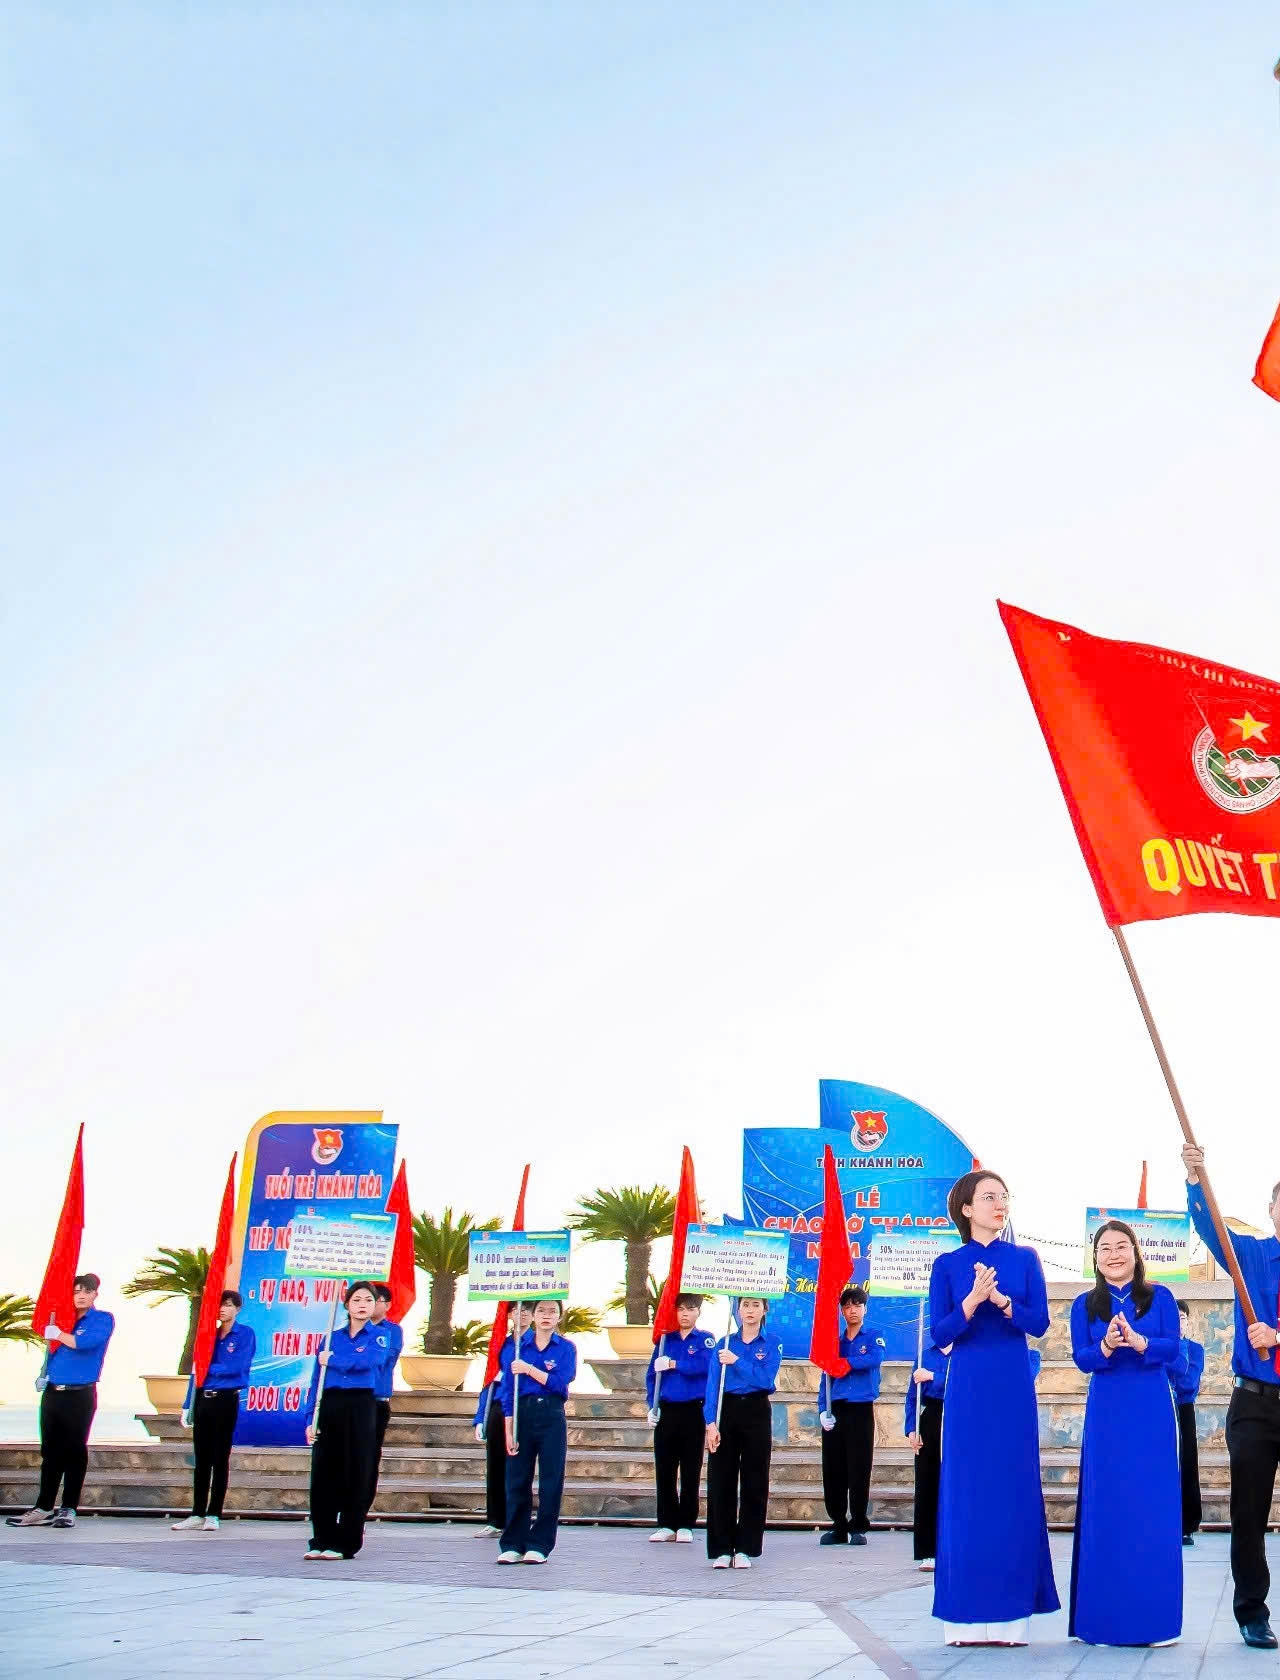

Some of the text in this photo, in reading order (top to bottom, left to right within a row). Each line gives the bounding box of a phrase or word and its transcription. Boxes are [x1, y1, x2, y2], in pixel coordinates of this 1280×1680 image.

[1141, 833, 1251, 896] QUYẾT
[816, 1154, 924, 1168] TH KHÁNH HÒA
[315, 1169, 357, 1199] KHÁNH
[357, 1169, 382, 1199] HÒA
[856, 1186, 880, 1208] LỄ
[249, 1218, 274, 1251] TIẾP
[274, 1218, 293, 1251] NỐ
[806, 1241, 862, 1260] NM
[880, 1245, 893, 1254] 50%
[474, 1253, 500, 1263] 40.000
[923, 1263, 931, 1271] 90
[903, 1272, 915, 1281] 80%
